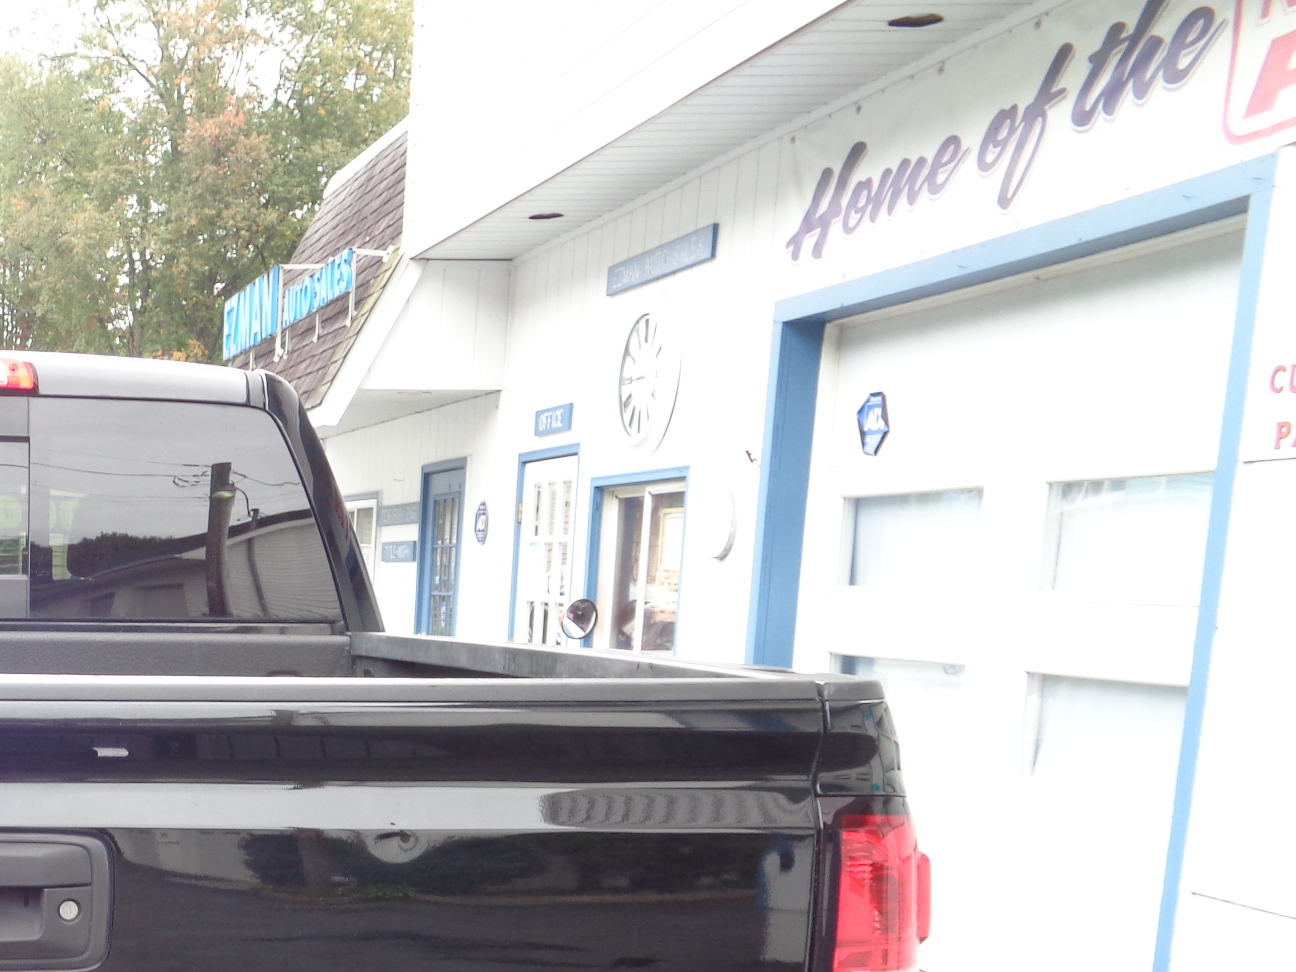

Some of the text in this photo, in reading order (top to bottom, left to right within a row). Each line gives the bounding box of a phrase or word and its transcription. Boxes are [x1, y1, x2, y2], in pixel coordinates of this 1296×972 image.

[786, 135, 972, 261] Home
[977, 41, 1074, 212] of
[1071, 0, 1229, 133] the
[283, 276, 314, 329] AUTO
[314, 249, 353, 309] SALES
[539, 408, 564, 431] OFFICE
